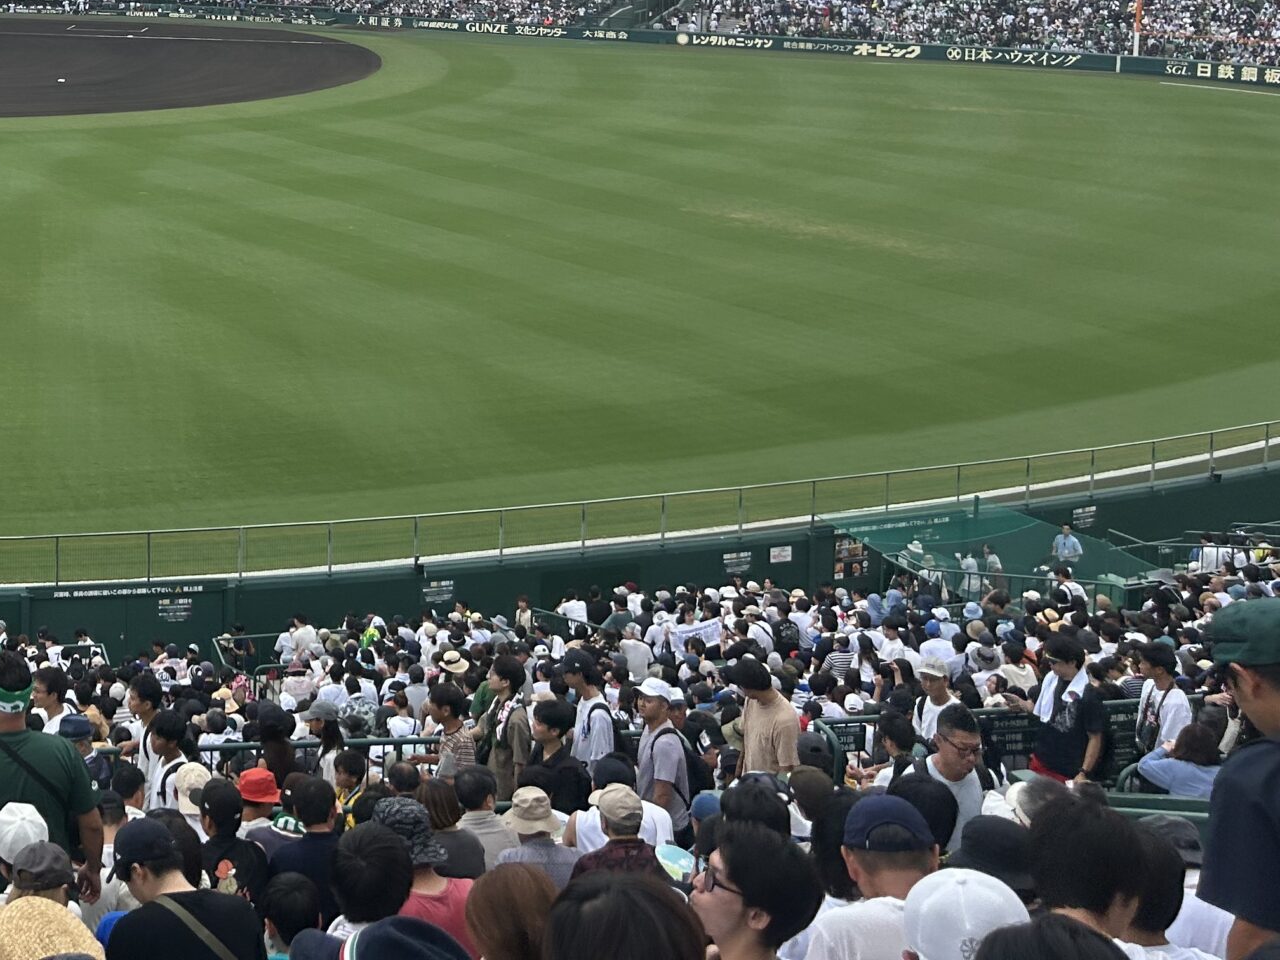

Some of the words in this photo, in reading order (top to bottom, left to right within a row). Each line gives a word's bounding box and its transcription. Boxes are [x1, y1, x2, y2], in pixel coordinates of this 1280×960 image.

[356, 15, 403, 28] 大和証券
[465, 22, 509, 35] GUNZE
[582, 30, 628, 40] 大塚商会
[692, 33, 774, 49] レンタルのニッケン
[852, 43, 921, 58] オービック
[964, 47, 1081, 68] 日本ハウズイング
[1196, 62, 1280, 84] 日鉄鋼板
